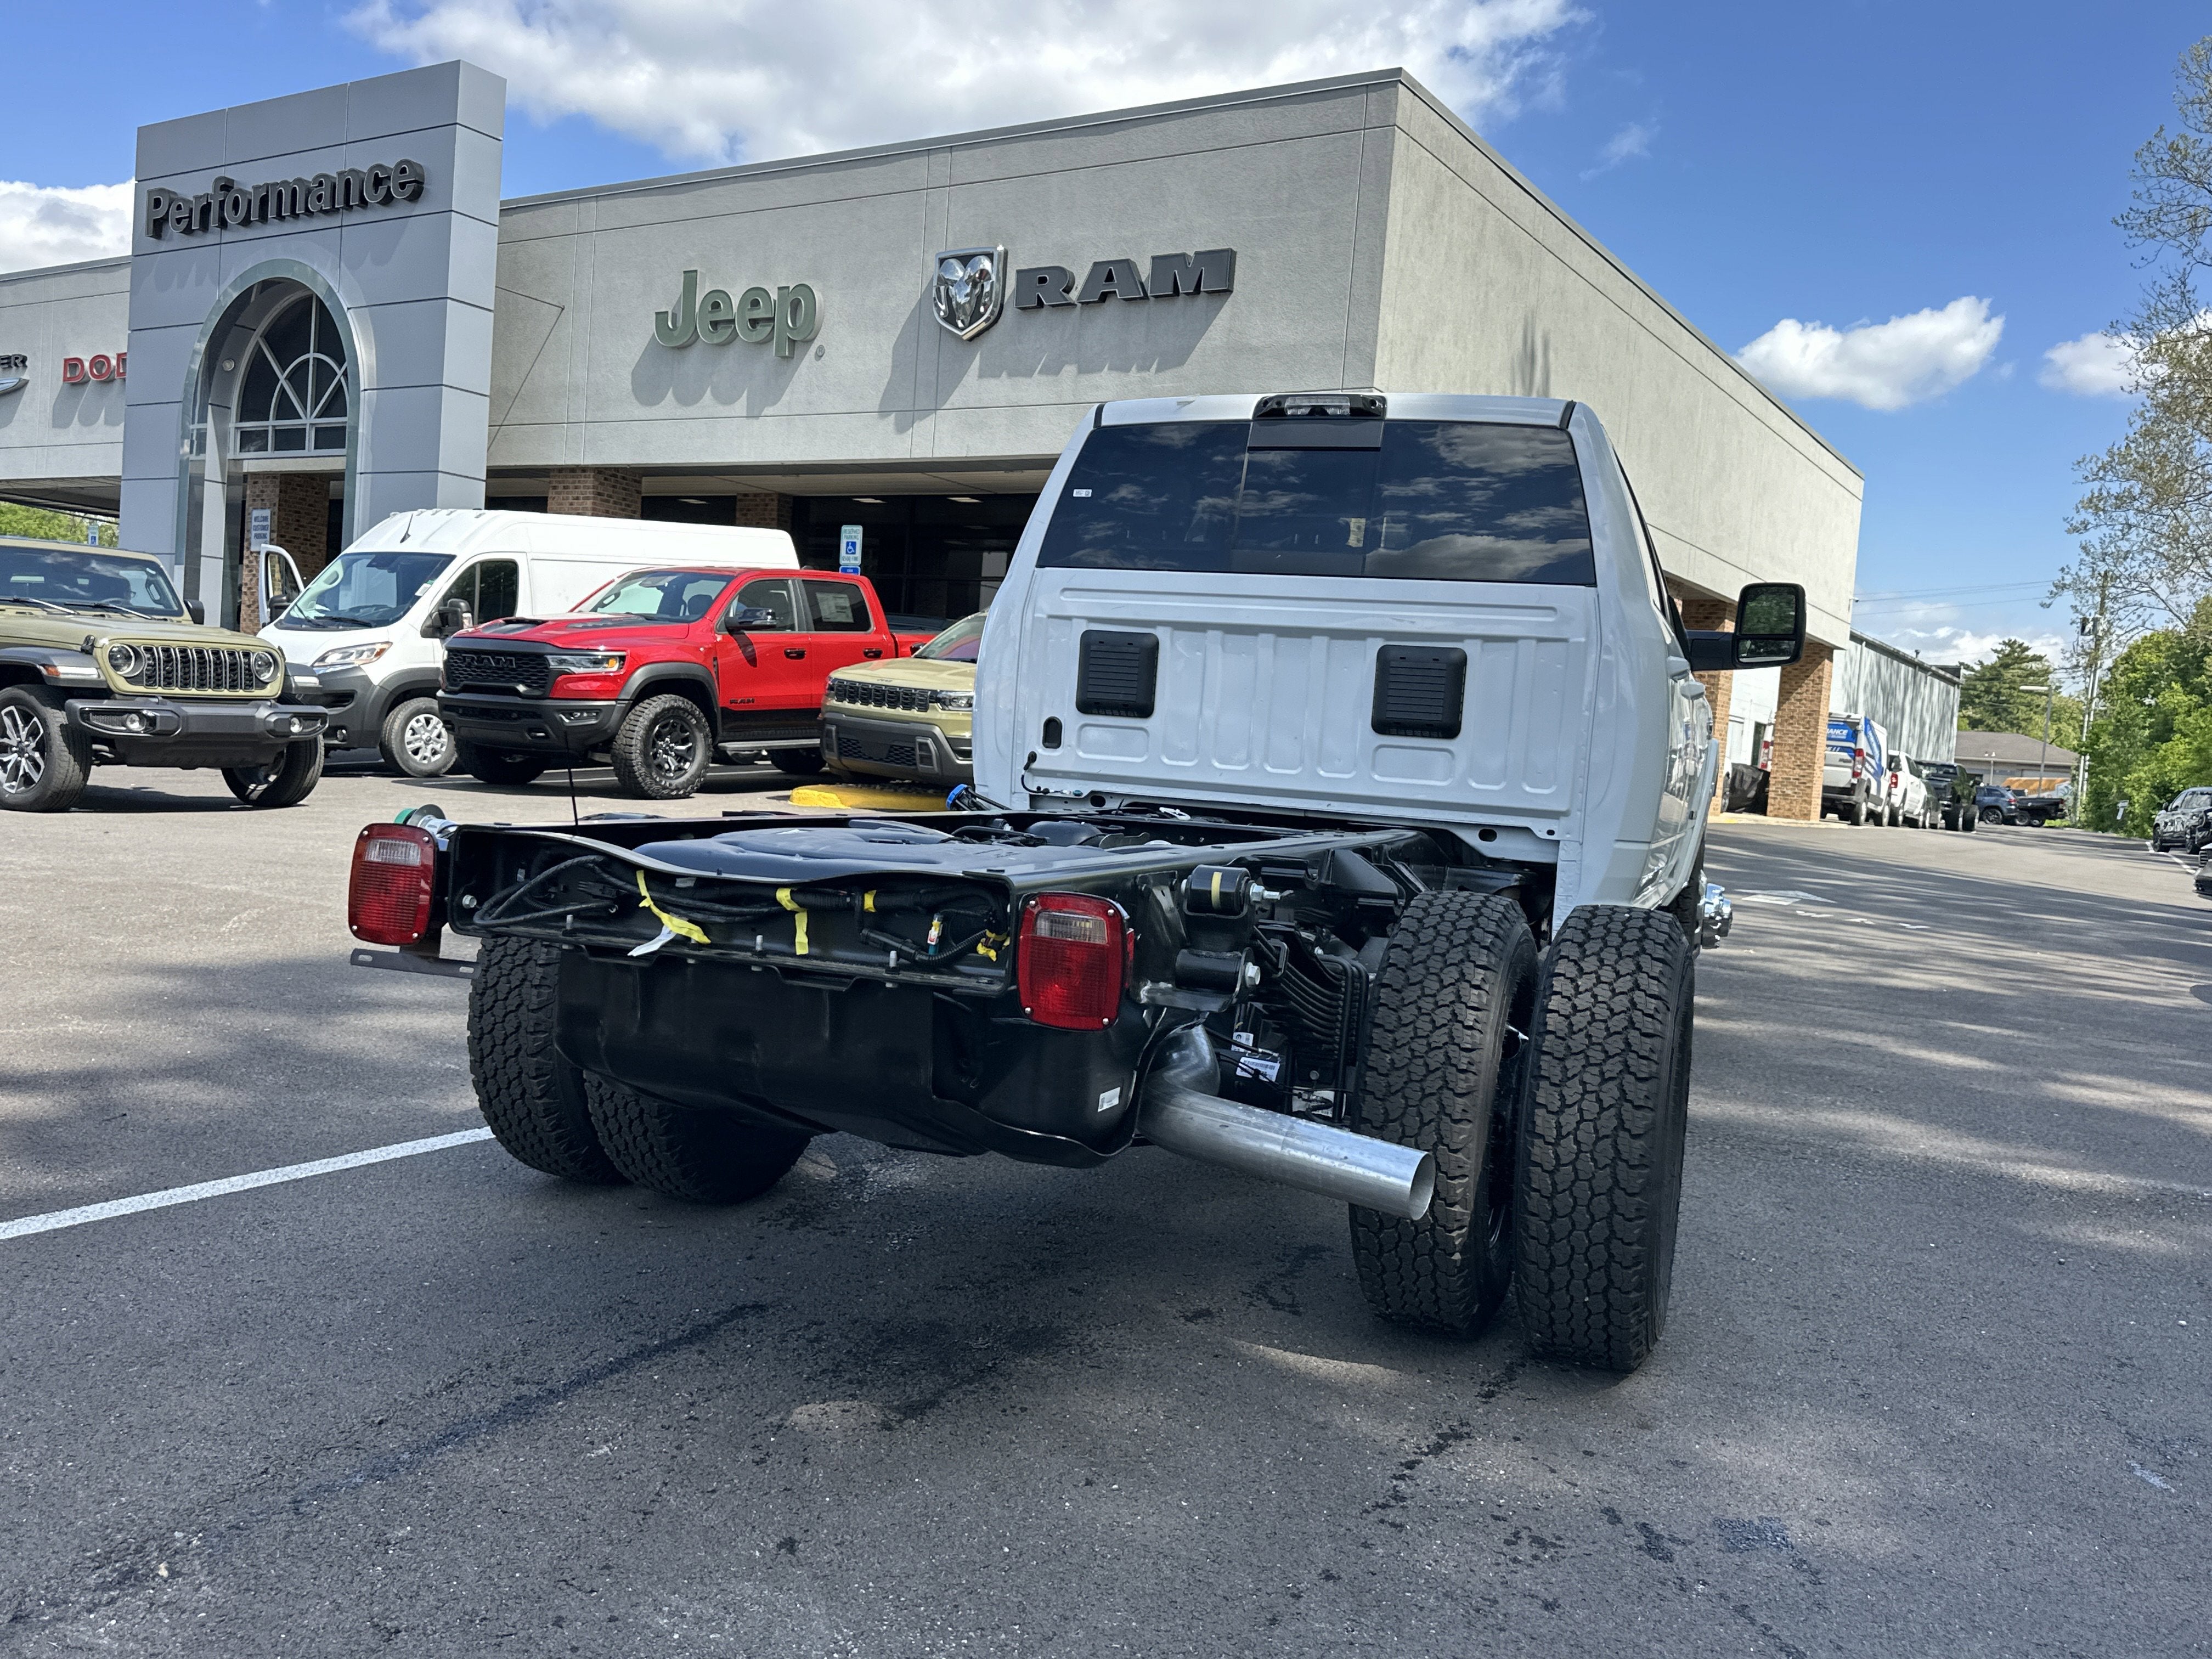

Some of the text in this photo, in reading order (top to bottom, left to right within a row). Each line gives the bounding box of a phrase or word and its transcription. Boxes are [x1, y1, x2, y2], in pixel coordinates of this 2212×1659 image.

[145, 159, 425, 238] Performance
[654, 269, 822, 357] Jeep
[1014, 248, 1237, 311] RAM
[461, 653, 516, 668] RAM
